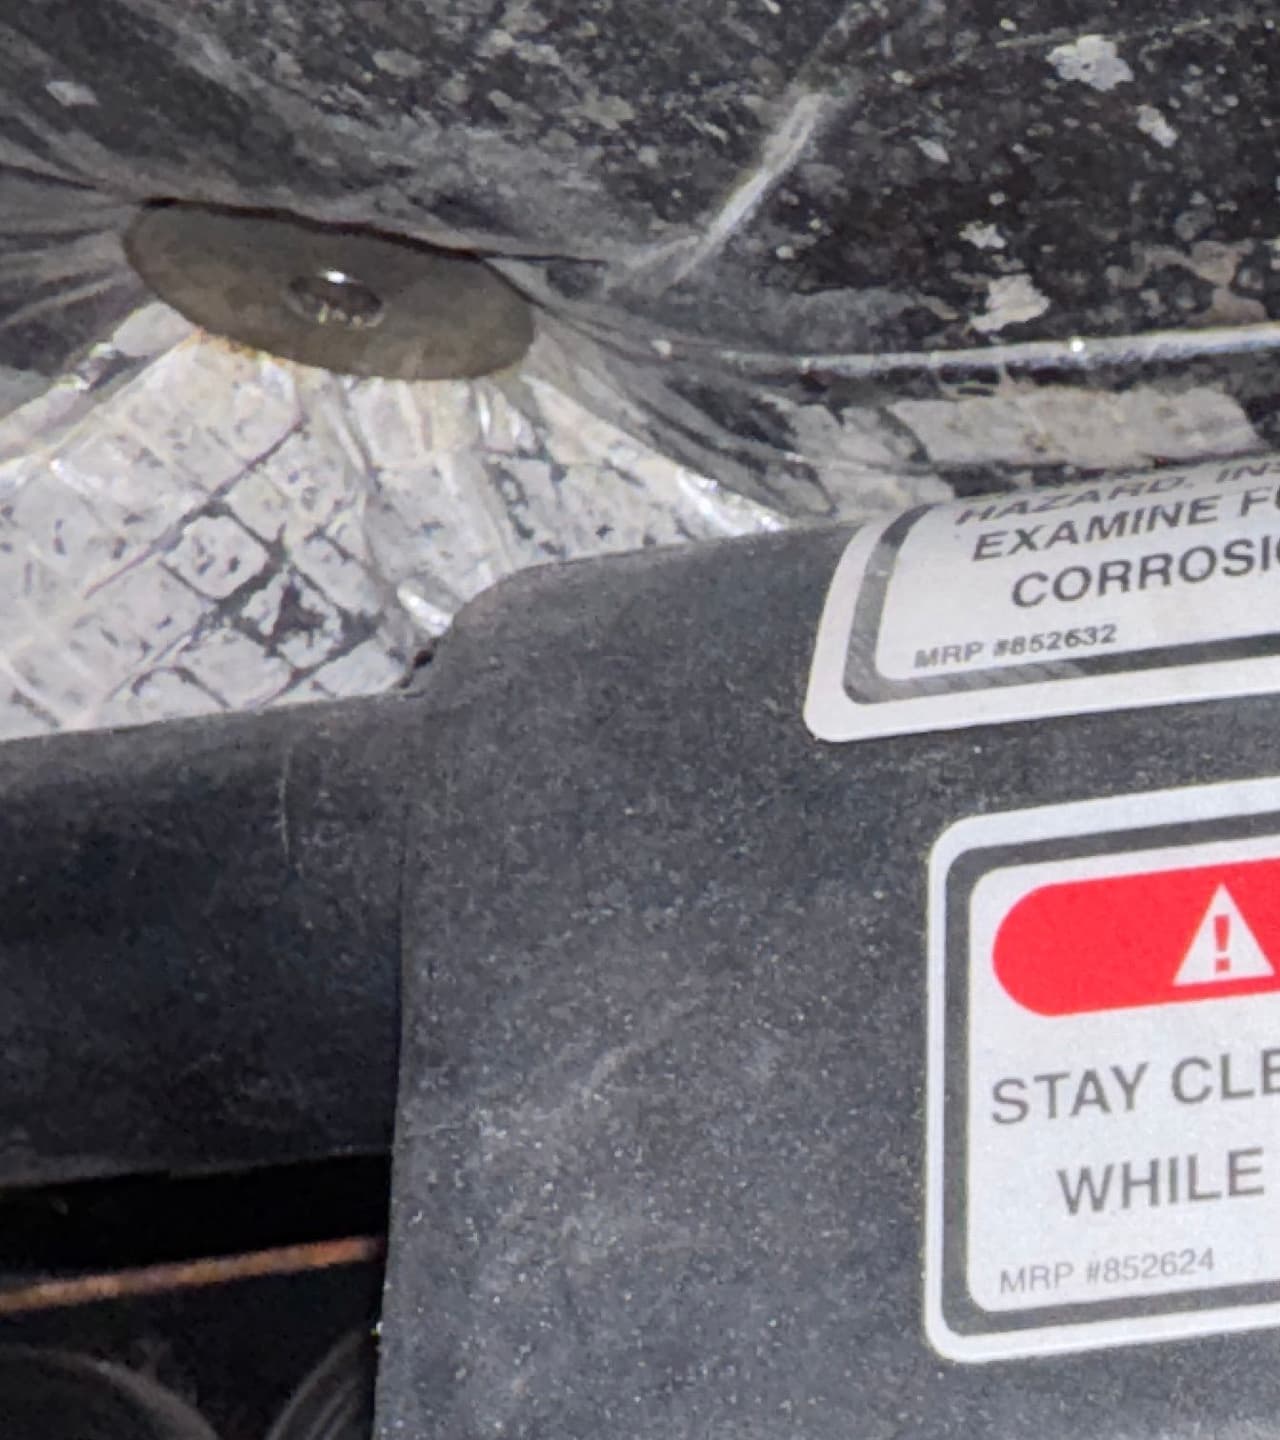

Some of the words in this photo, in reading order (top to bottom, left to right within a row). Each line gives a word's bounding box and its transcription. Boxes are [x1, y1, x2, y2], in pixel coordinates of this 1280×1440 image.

[954, 475, 1195, 526] HAZARD.
[971, 494, 1223, 562] EXAMINE
[913, 641, 983, 671] MRP
[991, 1060, 1150, 1126] STAY
[1056, 1146, 1266, 1217] WHILE
[998, 1262, 1074, 1296] MRP
[1085, 1246, 1216, 1284] #852624
